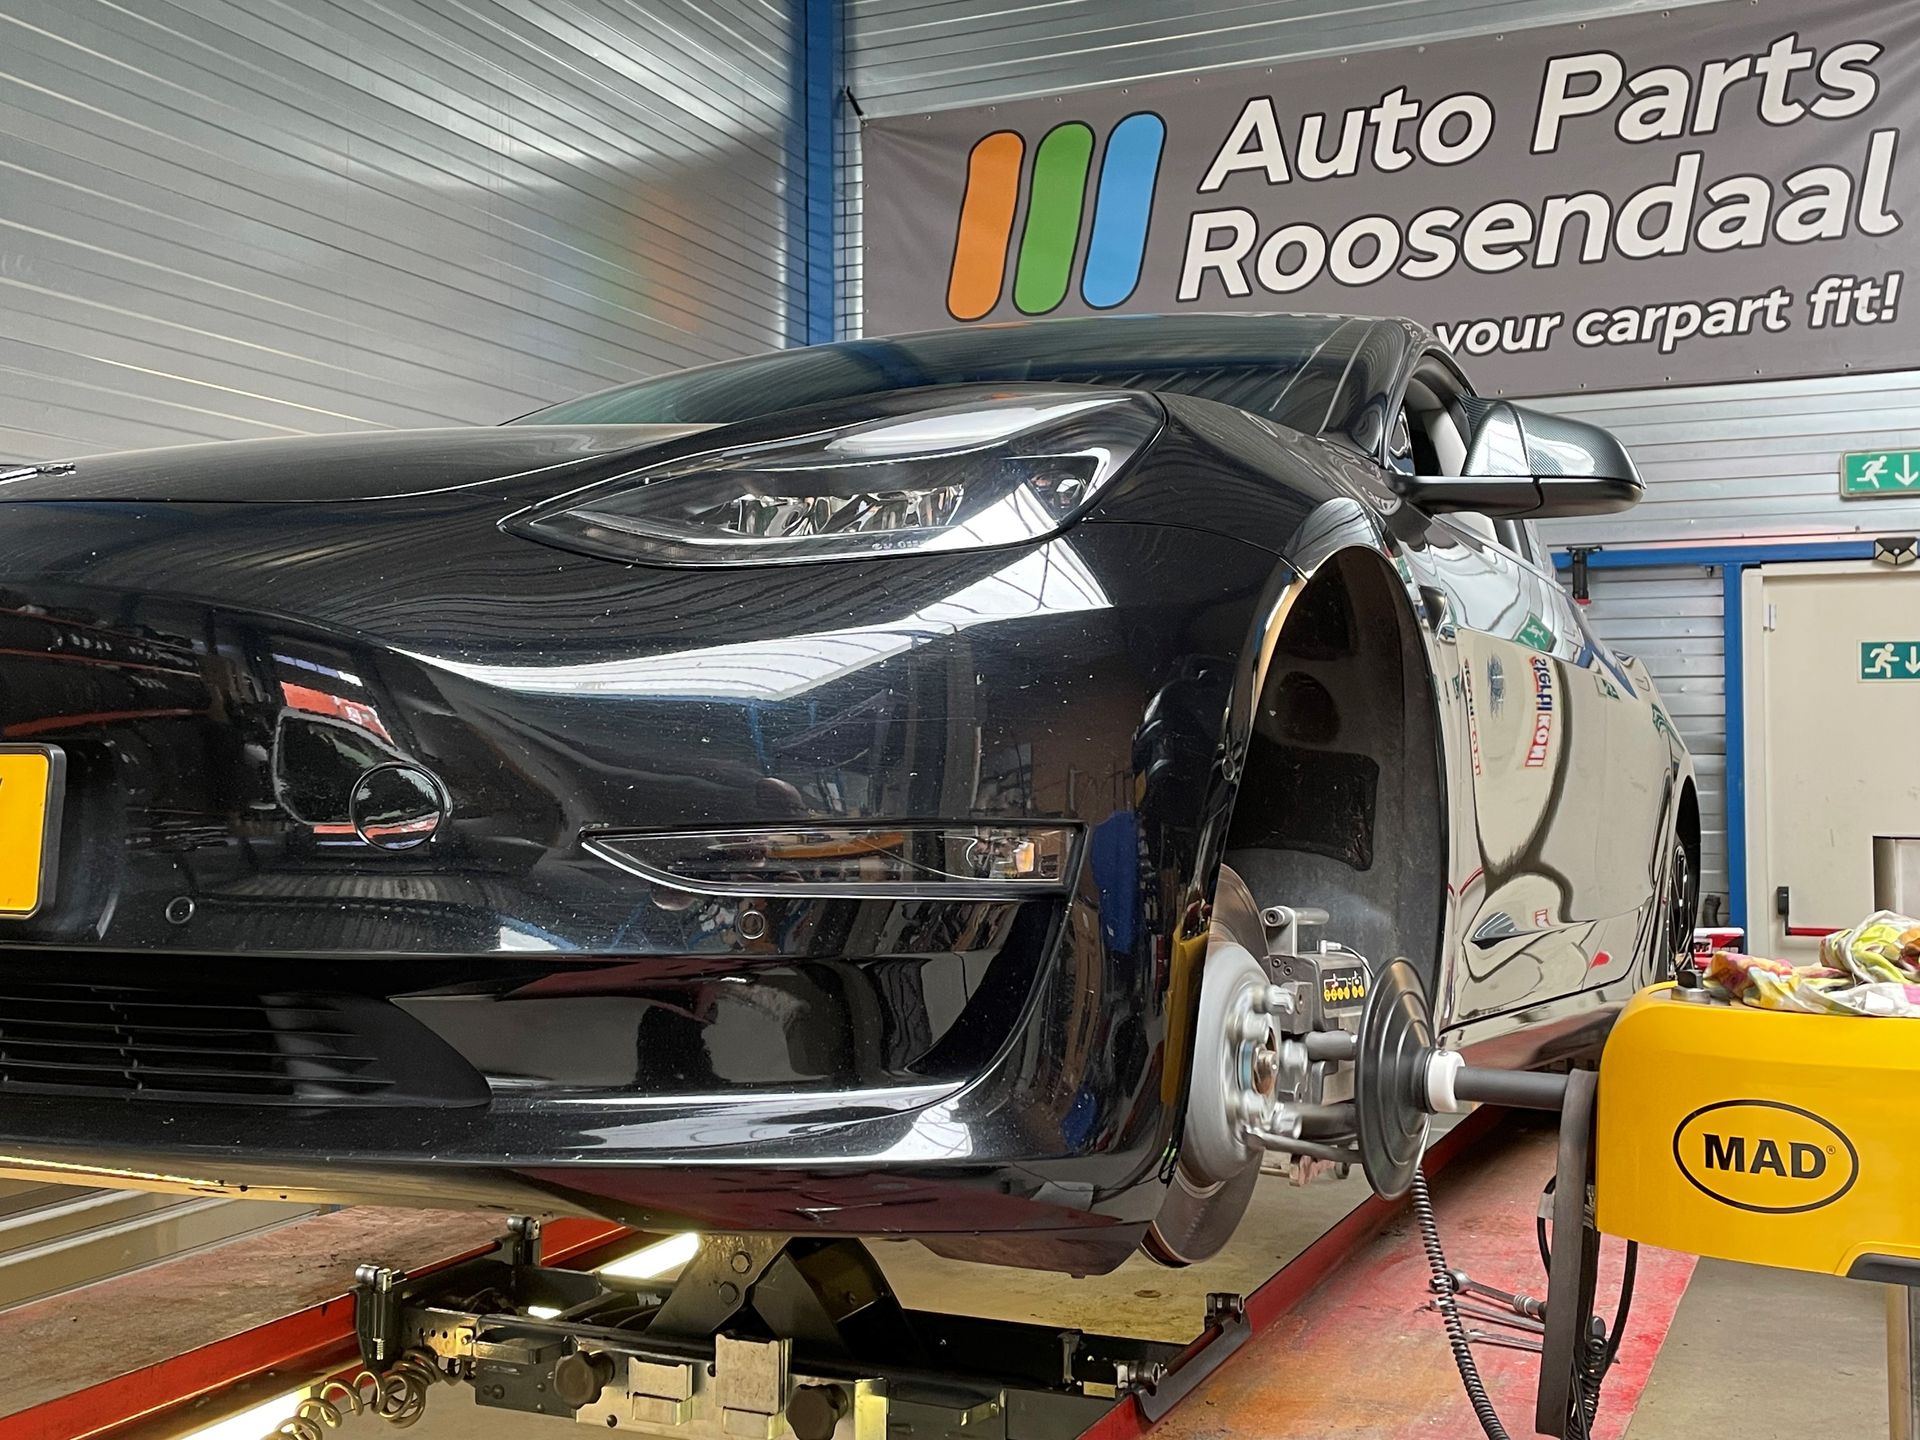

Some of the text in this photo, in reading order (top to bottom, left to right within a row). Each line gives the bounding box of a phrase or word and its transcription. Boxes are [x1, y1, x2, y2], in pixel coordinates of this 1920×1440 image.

[1200, 34, 1882, 192] Auto Parts
[1177, 130, 1901, 301] Roosendaal
[1435, 274, 1903, 354] your carpart fit!
[1702, 1133, 1828, 1179] MAD
